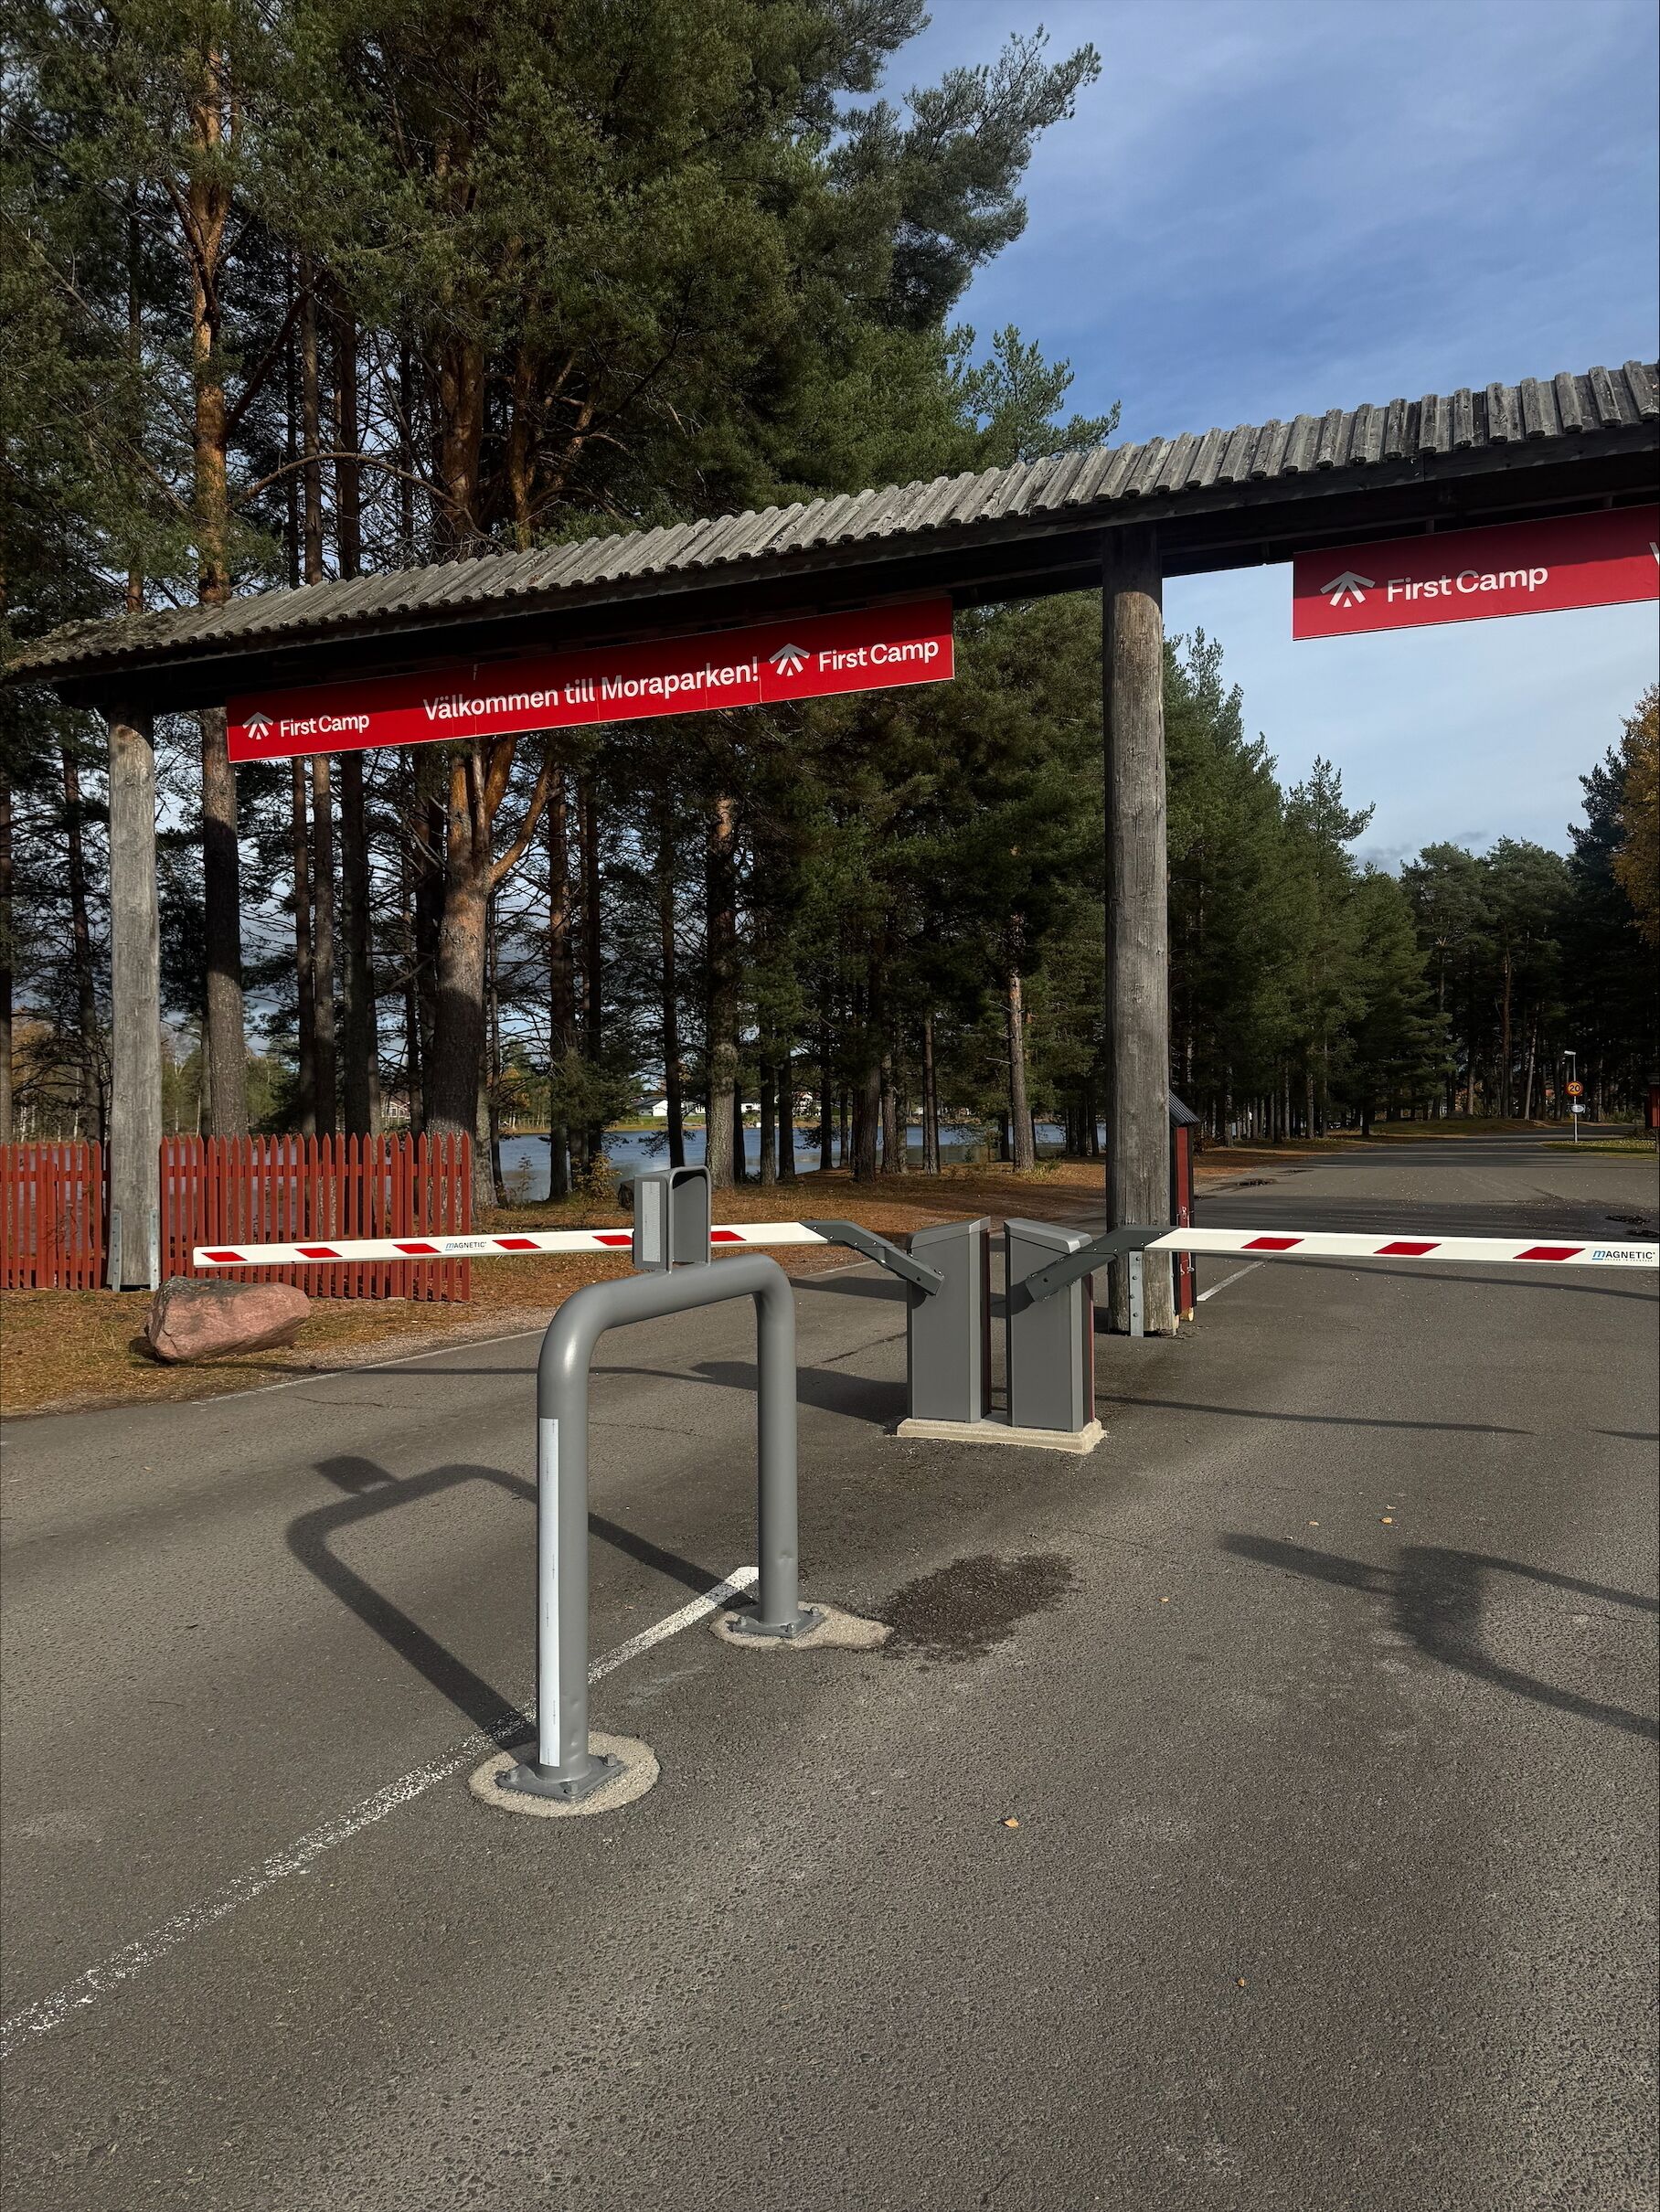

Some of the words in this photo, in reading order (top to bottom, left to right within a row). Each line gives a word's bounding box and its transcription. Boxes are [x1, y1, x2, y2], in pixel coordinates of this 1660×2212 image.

[1388, 575, 1452, 602] First
[1456, 567, 1548, 594] Camp
[819, 649, 867, 672] First
[870, 641, 939, 665] Camp
[423, 689, 559, 720] Välkommen
[564, 677, 596, 704] till
[601, 655, 759, 700] Moraparken!
[280, 718, 317, 738] First
[318, 715, 369, 734] Camp
[1570, 1084, 1580, 1092] 20
